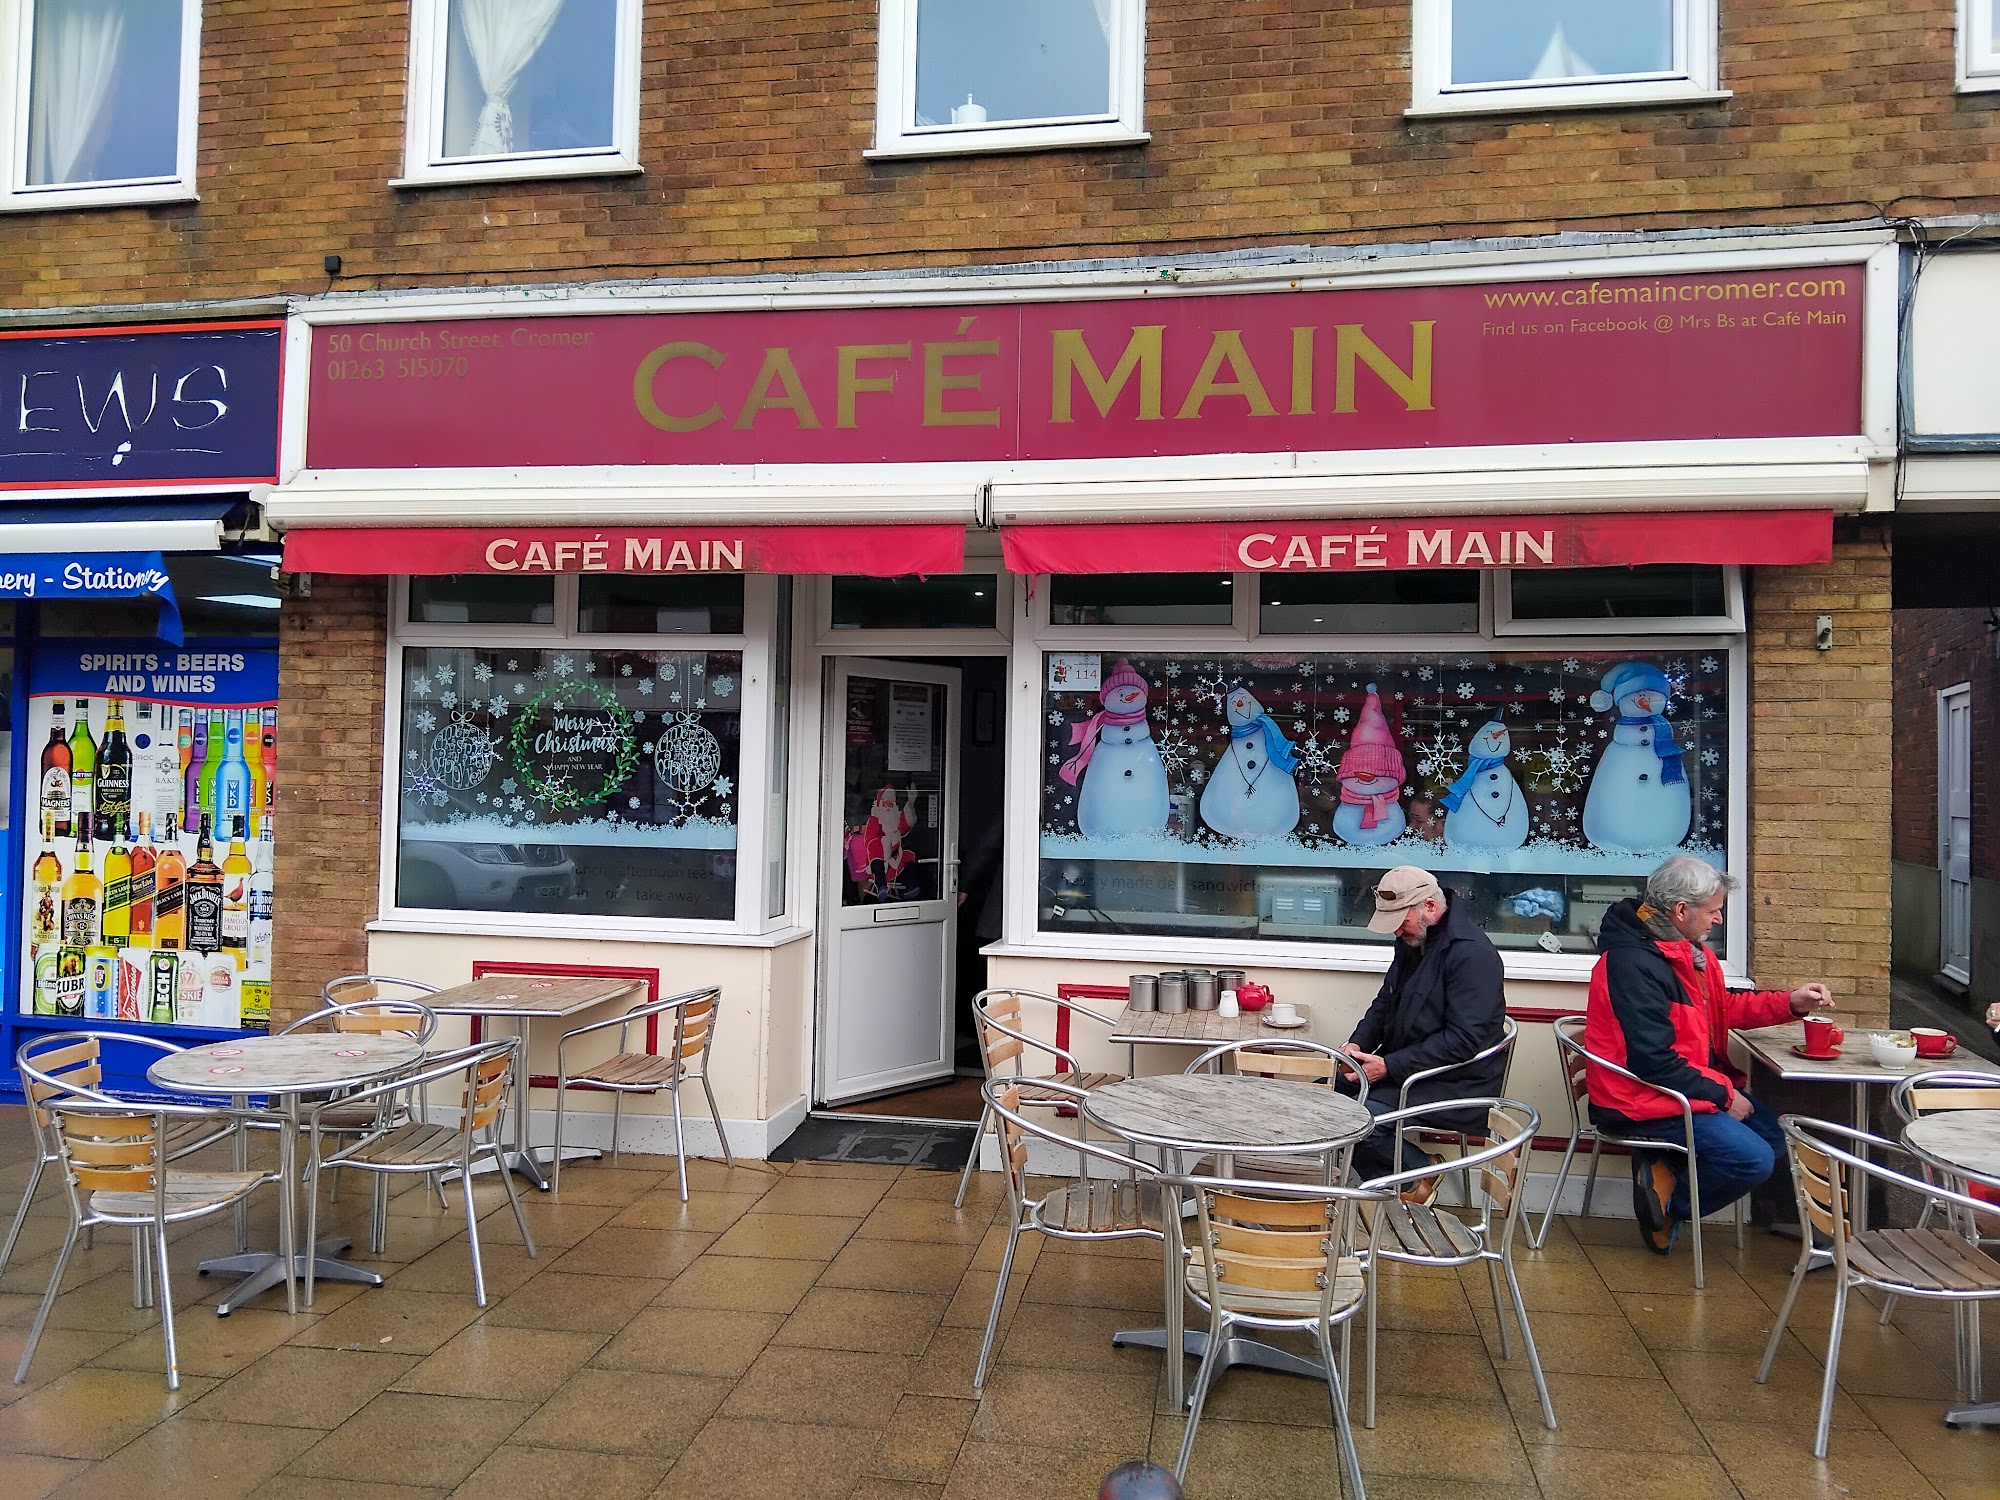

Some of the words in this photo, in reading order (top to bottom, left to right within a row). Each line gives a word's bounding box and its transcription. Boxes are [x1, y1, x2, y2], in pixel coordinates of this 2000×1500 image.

[1484, 278, 1846, 308] www.cafemaincromer.com
[1483, 322, 1515, 336] Find
[1521, 324, 1538, 335] us
[1544, 323, 1564, 334] on
[1570, 316, 1648, 333] Facebook
[1654, 315, 1674, 333] @
[1680, 316, 1711, 330] Mrs
[1717, 314, 1736, 329] Bs
[1741, 315, 1758, 328] at
[1763, 311, 1801, 327] Café
[1807, 310, 1846, 326] Main
[328, 334, 351, 354] 50
[359, 331, 432, 353] Church
[511, 327, 594, 348] Cromer
[328, 359, 385, 381] 01263
[399, 357, 468, 379] 515070
[633, 316, 1001, 433] CAFÉ
[1048, 320, 1437, 424] MAIN
[485, 534, 609, 571] CAFÉ
[623, 537, 744, 571] MAIN
[1237, 525, 1388, 569] CAFÉ
[1407, 529, 1555, 565] MAIN
[80, 653, 159, 672] SPIRITS
[176, 654, 245, 672] BEERS
[1076, 669, 1098, 679] 114
[105, 675, 146, 693] AND
[151, 675, 216, 693] WINES
[553, 713, 593, 735] Merry
[535, 730, 614, 754] Christmas
[97, 778, 129, 788] GUINNESS
[229, 781, 238, 806] WKD
[41, 798, 70, 807] MAGNERS
[1112, 874, 1153, 889] made
[636, 888, 664, 901] take
[667, 891, 701, 905] away
[224, 924, 247, 932] GROUSE
[157, 972, 170, 1010] LECH
[180, 989, 202, 1001] SKIE
